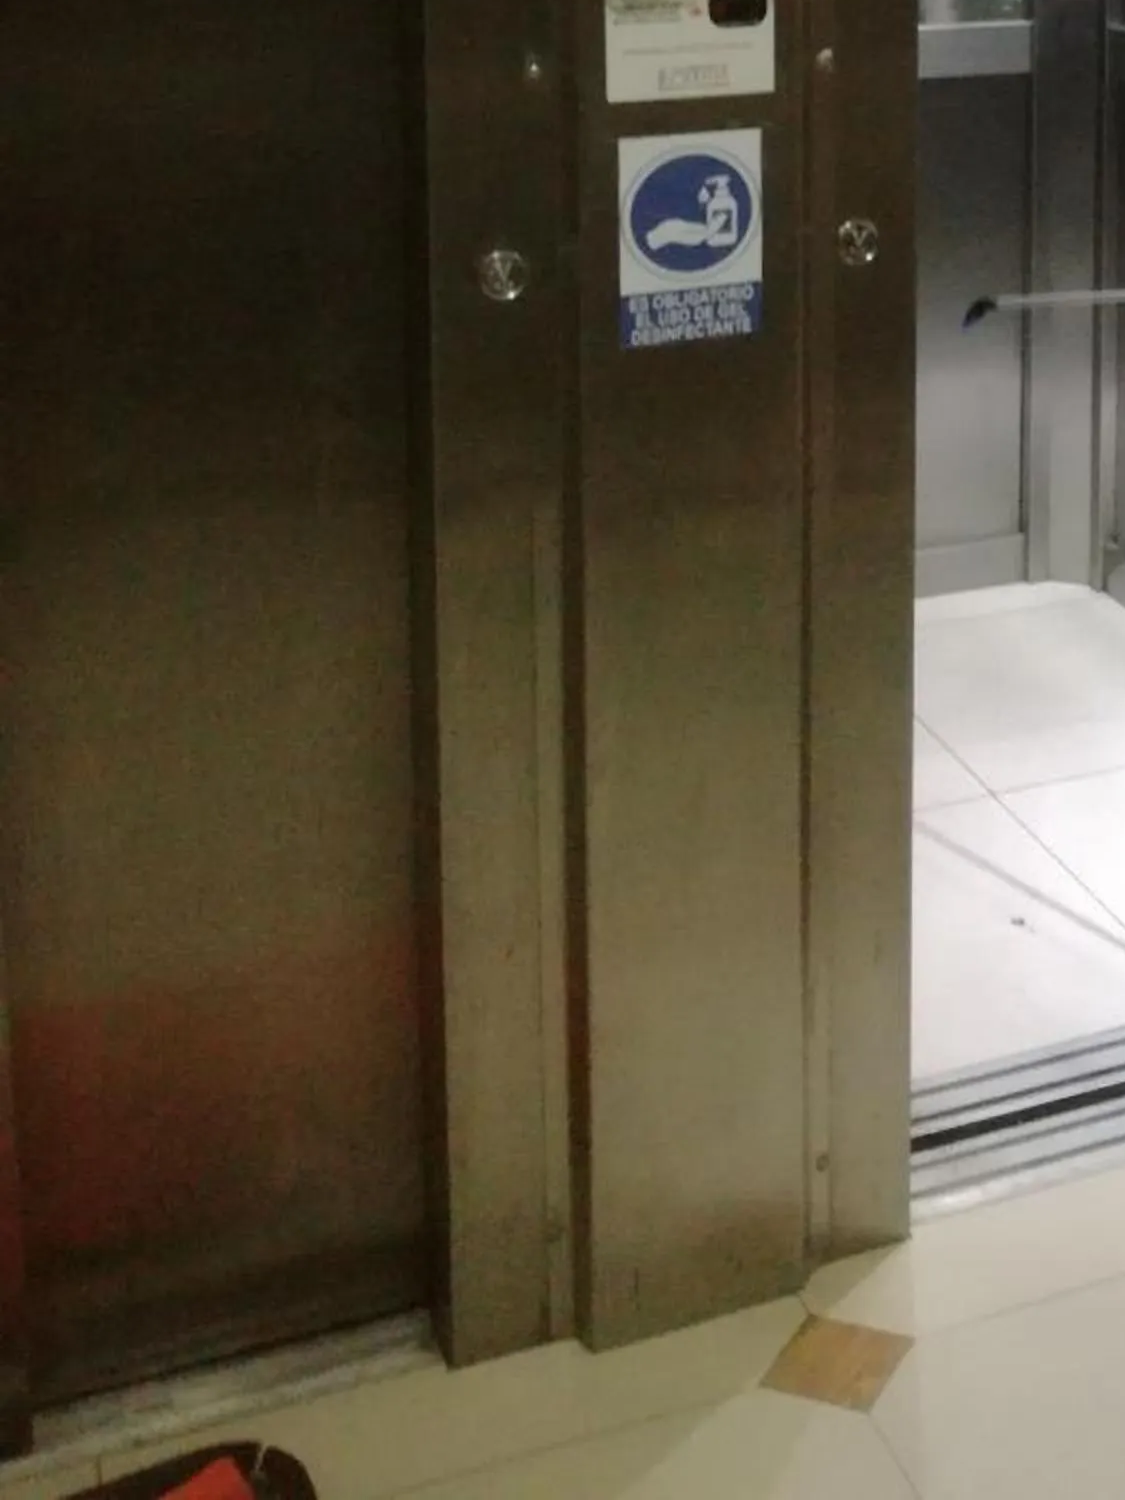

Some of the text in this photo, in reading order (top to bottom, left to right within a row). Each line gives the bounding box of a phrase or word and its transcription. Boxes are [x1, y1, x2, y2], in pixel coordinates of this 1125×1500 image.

[629, 286, 754, 311] ES OBLIGATORIO
[635, 299, 747, 329] EL USO DE GEL
[630, 317, 752, 346] DESINFECTANTE
